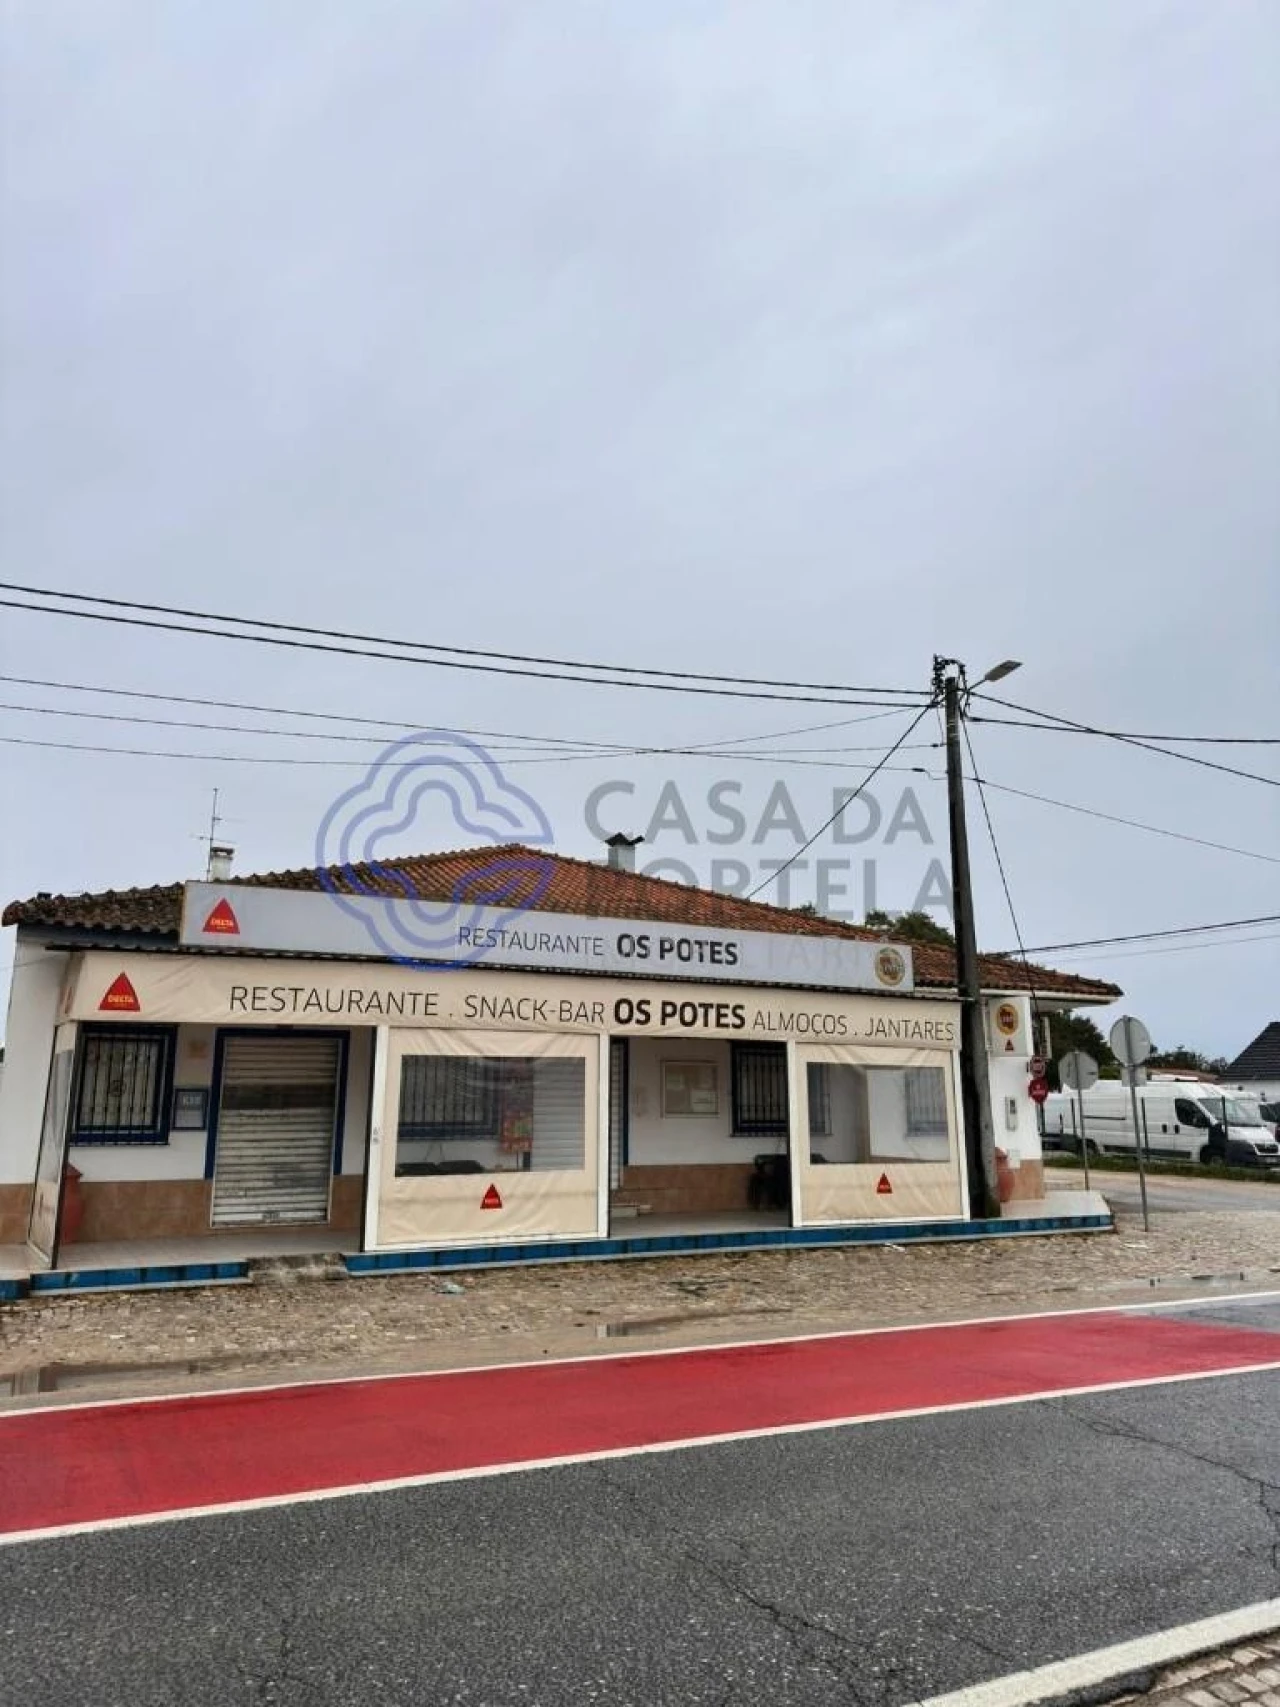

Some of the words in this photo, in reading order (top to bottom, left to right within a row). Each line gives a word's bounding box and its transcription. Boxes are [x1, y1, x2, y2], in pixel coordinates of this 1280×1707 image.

[458, 925, 605, 957] RESTAURANTE
[616, 933, 651, 960] OS
[658, 937, 739, 966] POTES
[228, 986, 440, 1017] RESTAURANTE
[463, 994, 605, 1026] SNACK-BAR
[613, 998, 651, 1026] OS
[660, 1001, 747, 1030] POTES
[752, 1009, 848, 1036] ALMOÇOS
[864, 1016, 955, 1042] JANTARES
